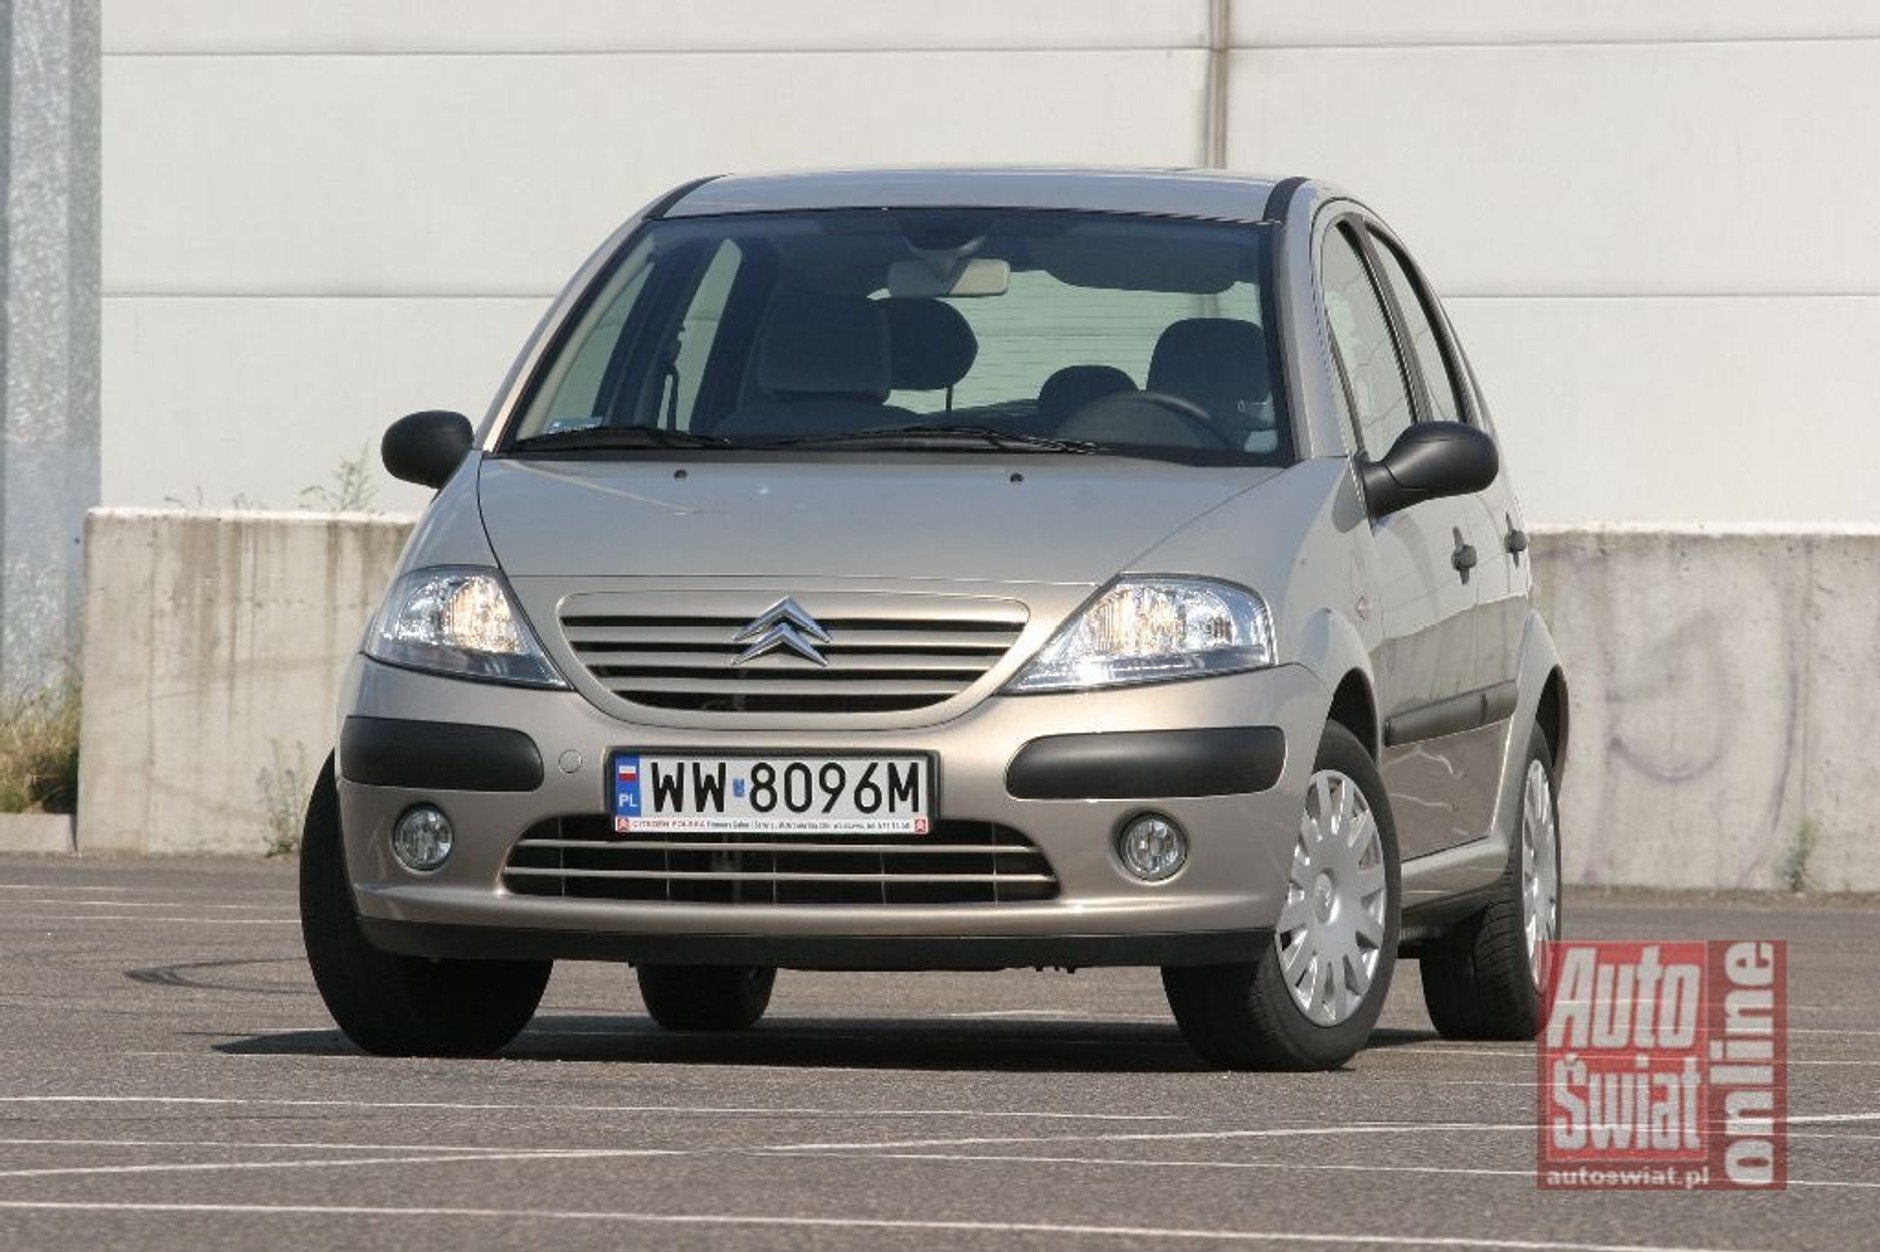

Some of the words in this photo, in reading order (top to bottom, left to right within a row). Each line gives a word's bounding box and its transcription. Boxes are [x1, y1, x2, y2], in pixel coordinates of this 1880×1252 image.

[618, 793, 638, 808] PL
[651, 762, 726, 812] WW
[750, 762, 919, 813] 8096M
